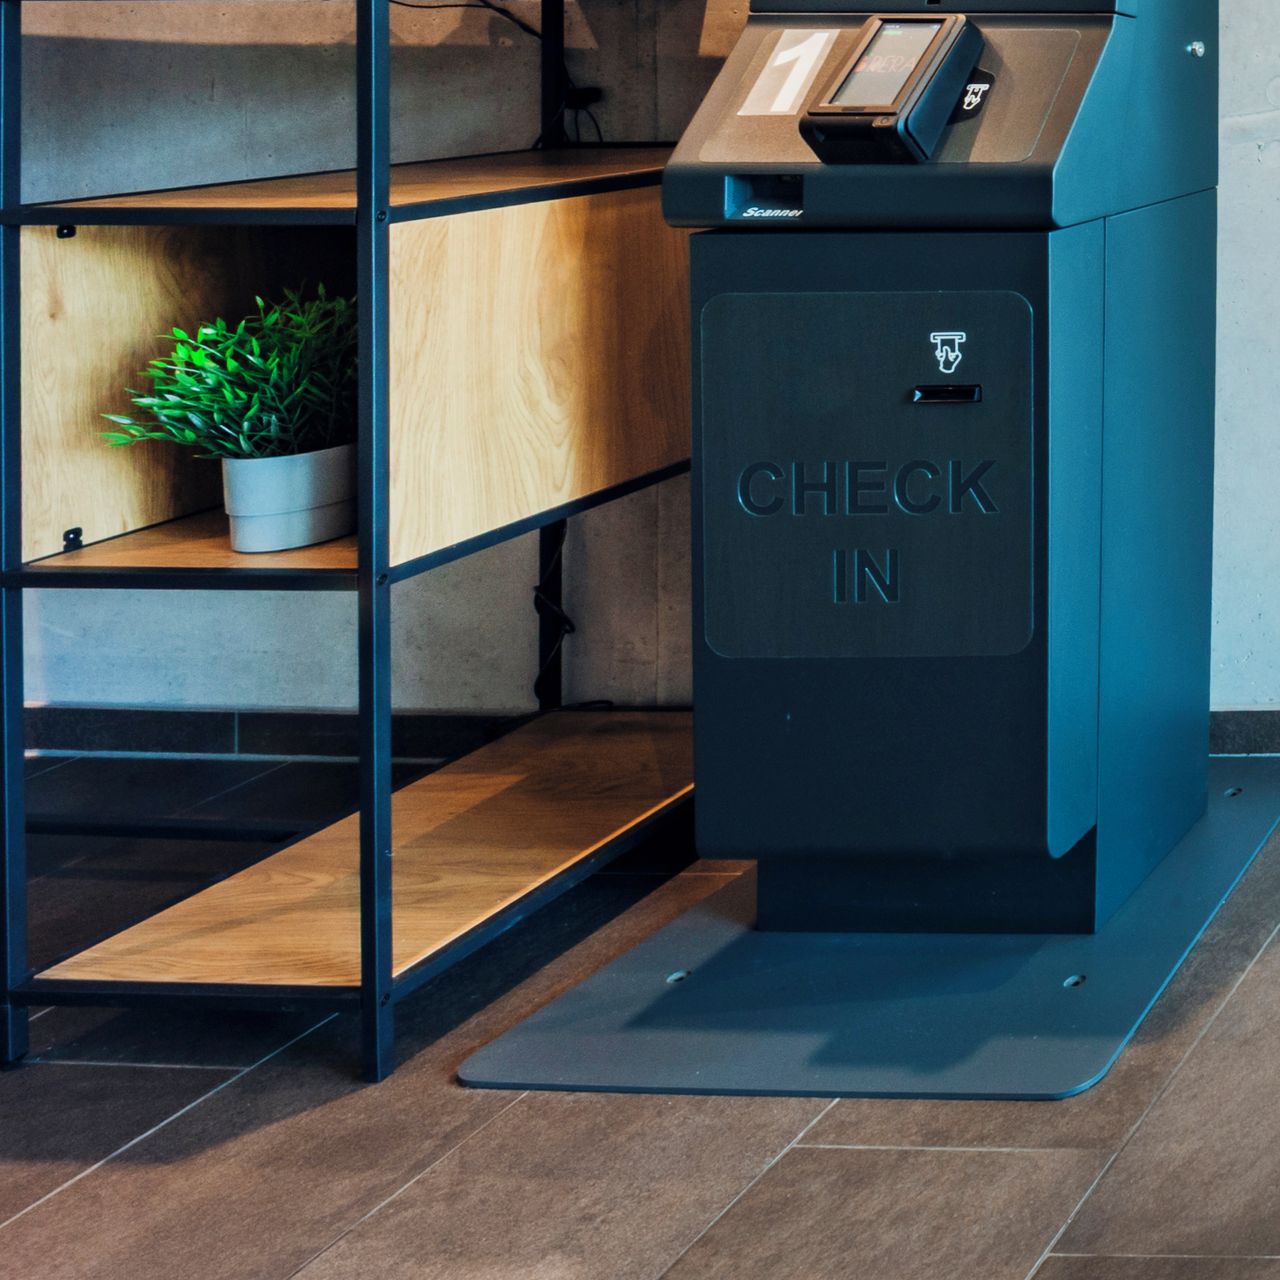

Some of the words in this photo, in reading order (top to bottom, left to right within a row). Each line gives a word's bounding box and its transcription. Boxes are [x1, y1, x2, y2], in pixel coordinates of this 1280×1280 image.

[772, 31, 830, 113] 1
[742, 207, 804, 217] Scanner
[736, 459, 1000, 517] CHECK
[833, 548, 900, 604] IN
